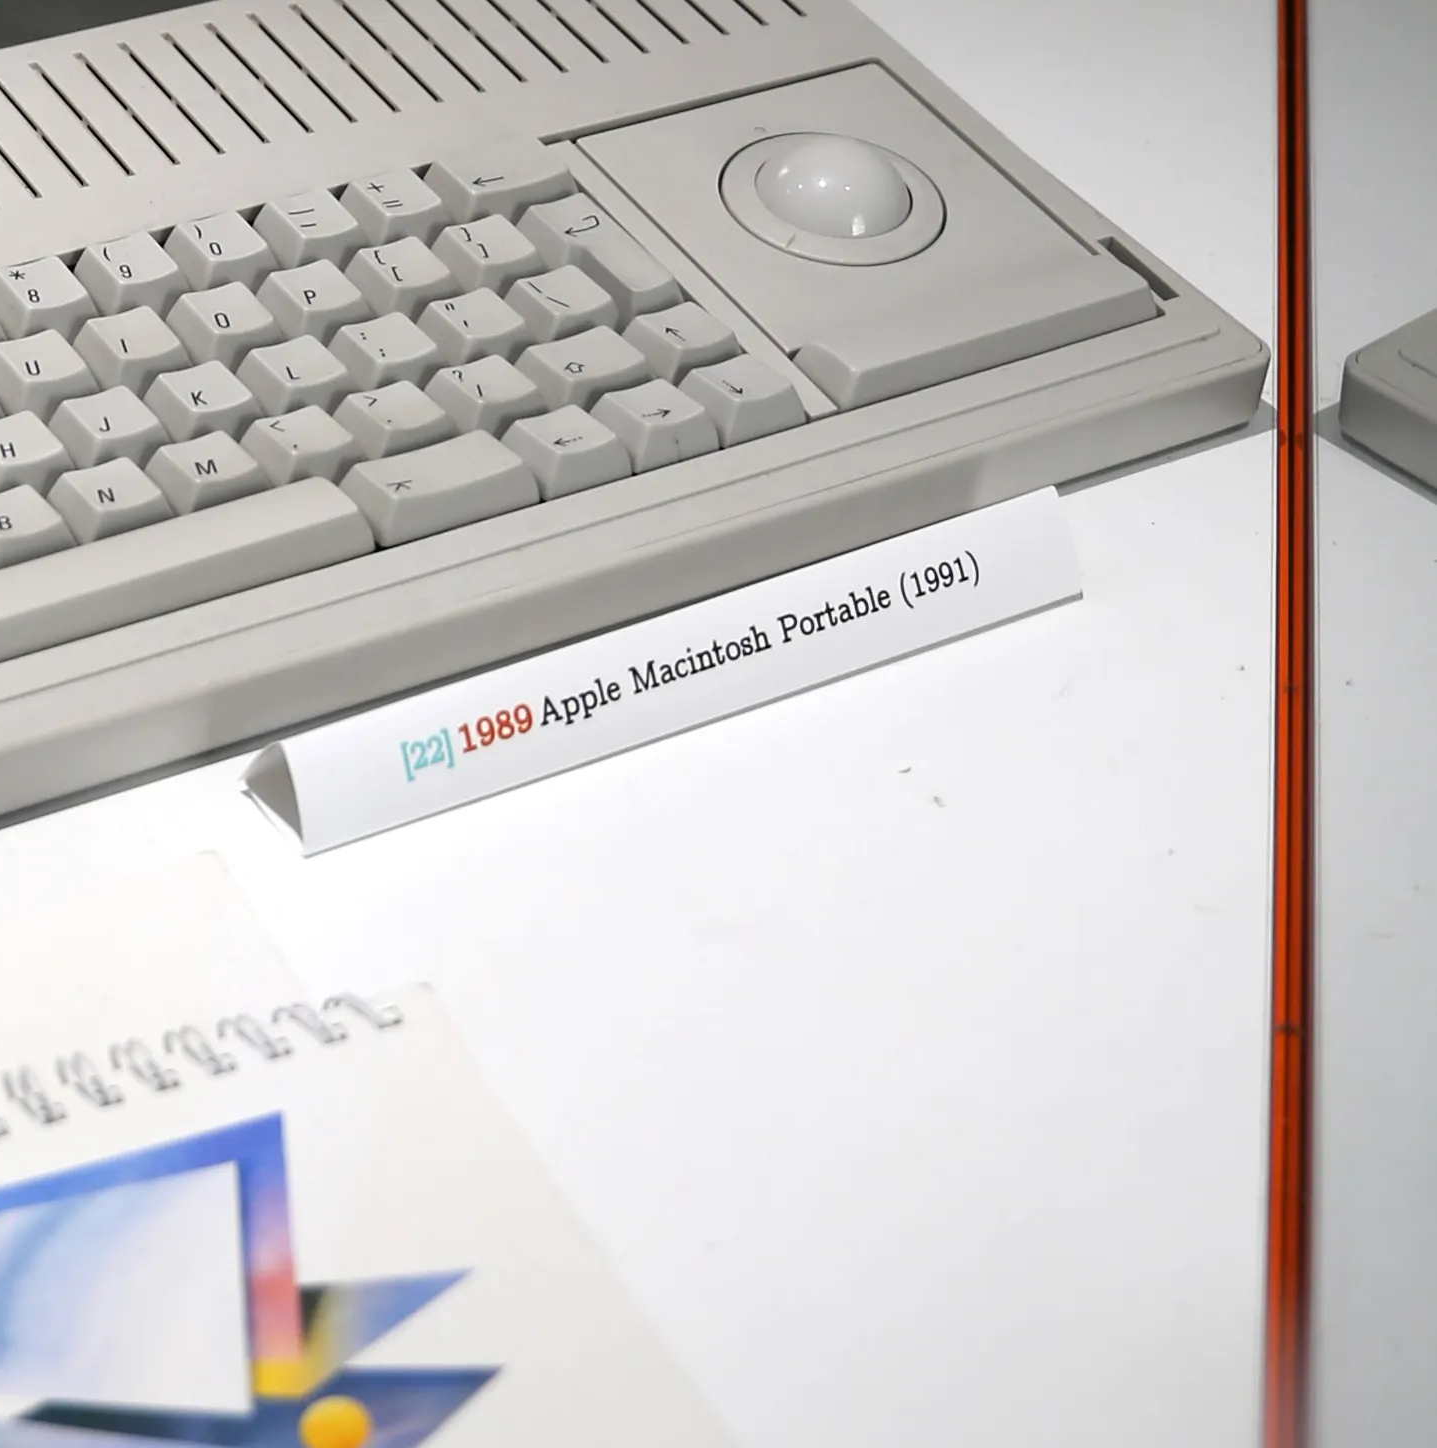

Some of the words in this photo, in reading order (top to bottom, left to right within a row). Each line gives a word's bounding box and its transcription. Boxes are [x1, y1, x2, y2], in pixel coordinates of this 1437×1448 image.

[366, 181, 386, 195] +
[382, 199, 404, 209] =
[194, 225, 202, 239] )
[460, 227, 472, 242] }
[103, 247, 111, 262] (
[373, 250, 386, 266] {
[477, 243, 489, 259] ]
[119, 264, 133, 279] 9
[391, 266, 403, 282] [
[27, 289, 41, 303] 8
[303, 289, 317, 305] P
[25, 360, 41, 376] U
[286, 366, 300, 380] L
[452, 370, 463, 382] ?
[190, 390, 207, 406] K
[99, 416, 111, 432] J
[269, 420, 285, 432] <
[0, 442, 16, 459] H
[194, 459, 218, 476] M
[97, 487, 116, 504] N
[401, 729, 455, 782] [22]
[459, 704, 532, 753] 1989
[541, 679, 621, 726] Apple
[629, 626, 771, 694] Macintosh
[777, 587, 891, 643] Portable
[901, 551, 979, 608] (1991)
